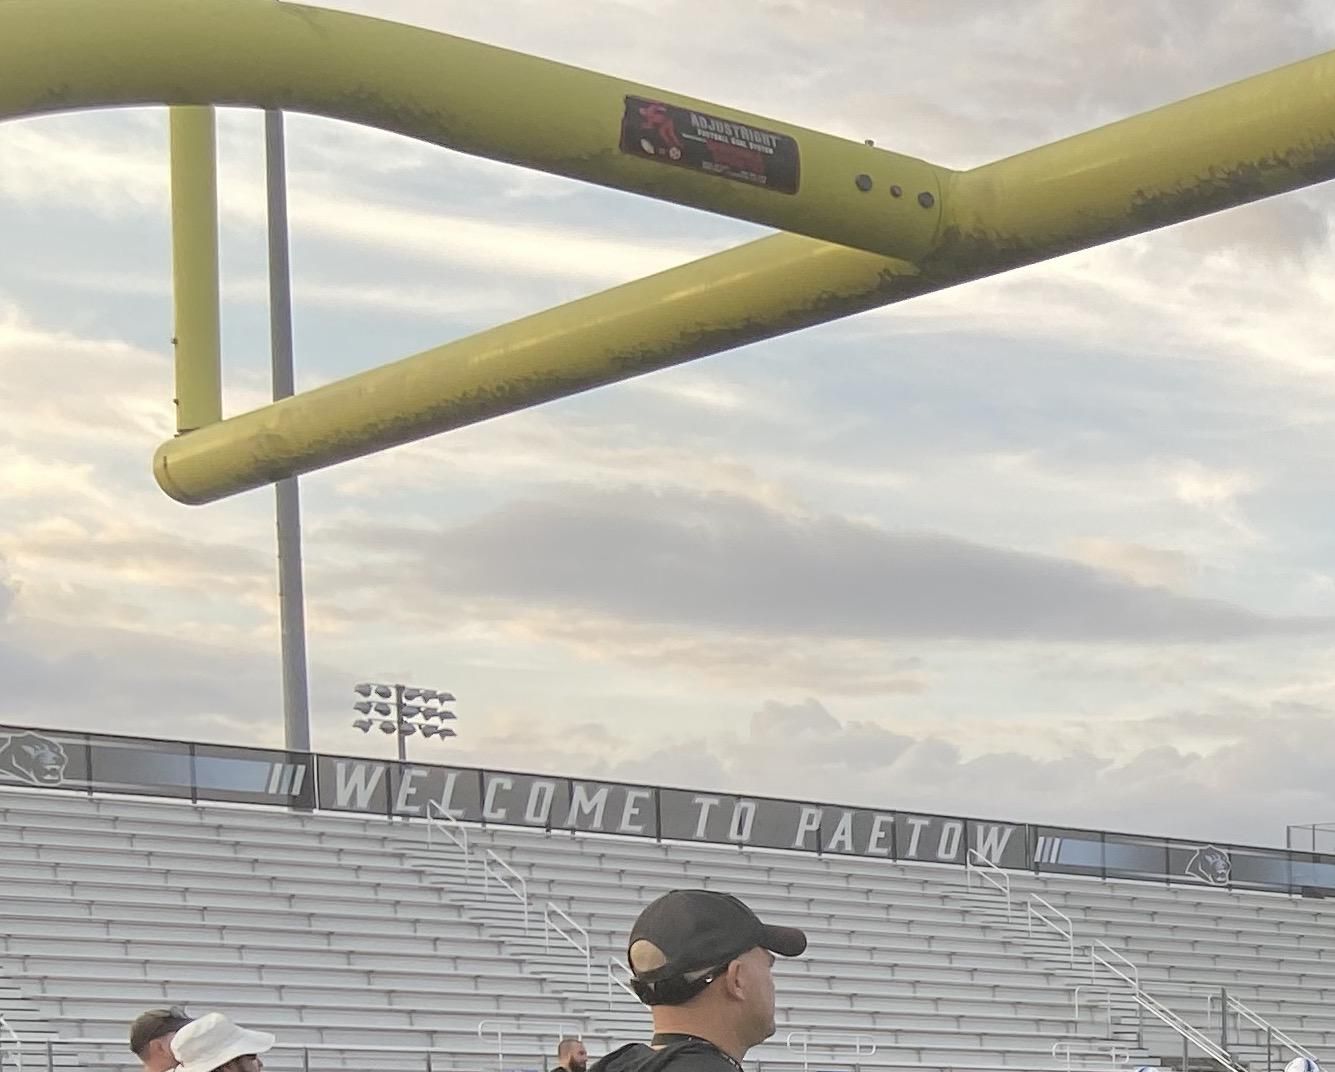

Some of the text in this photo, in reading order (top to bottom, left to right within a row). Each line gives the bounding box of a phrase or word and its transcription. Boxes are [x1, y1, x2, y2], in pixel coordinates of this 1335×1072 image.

[690, 112, 778, 148] ADJUSTRIGHT
[332, 758, 1016, 864] WELCOME TO PAETOW
